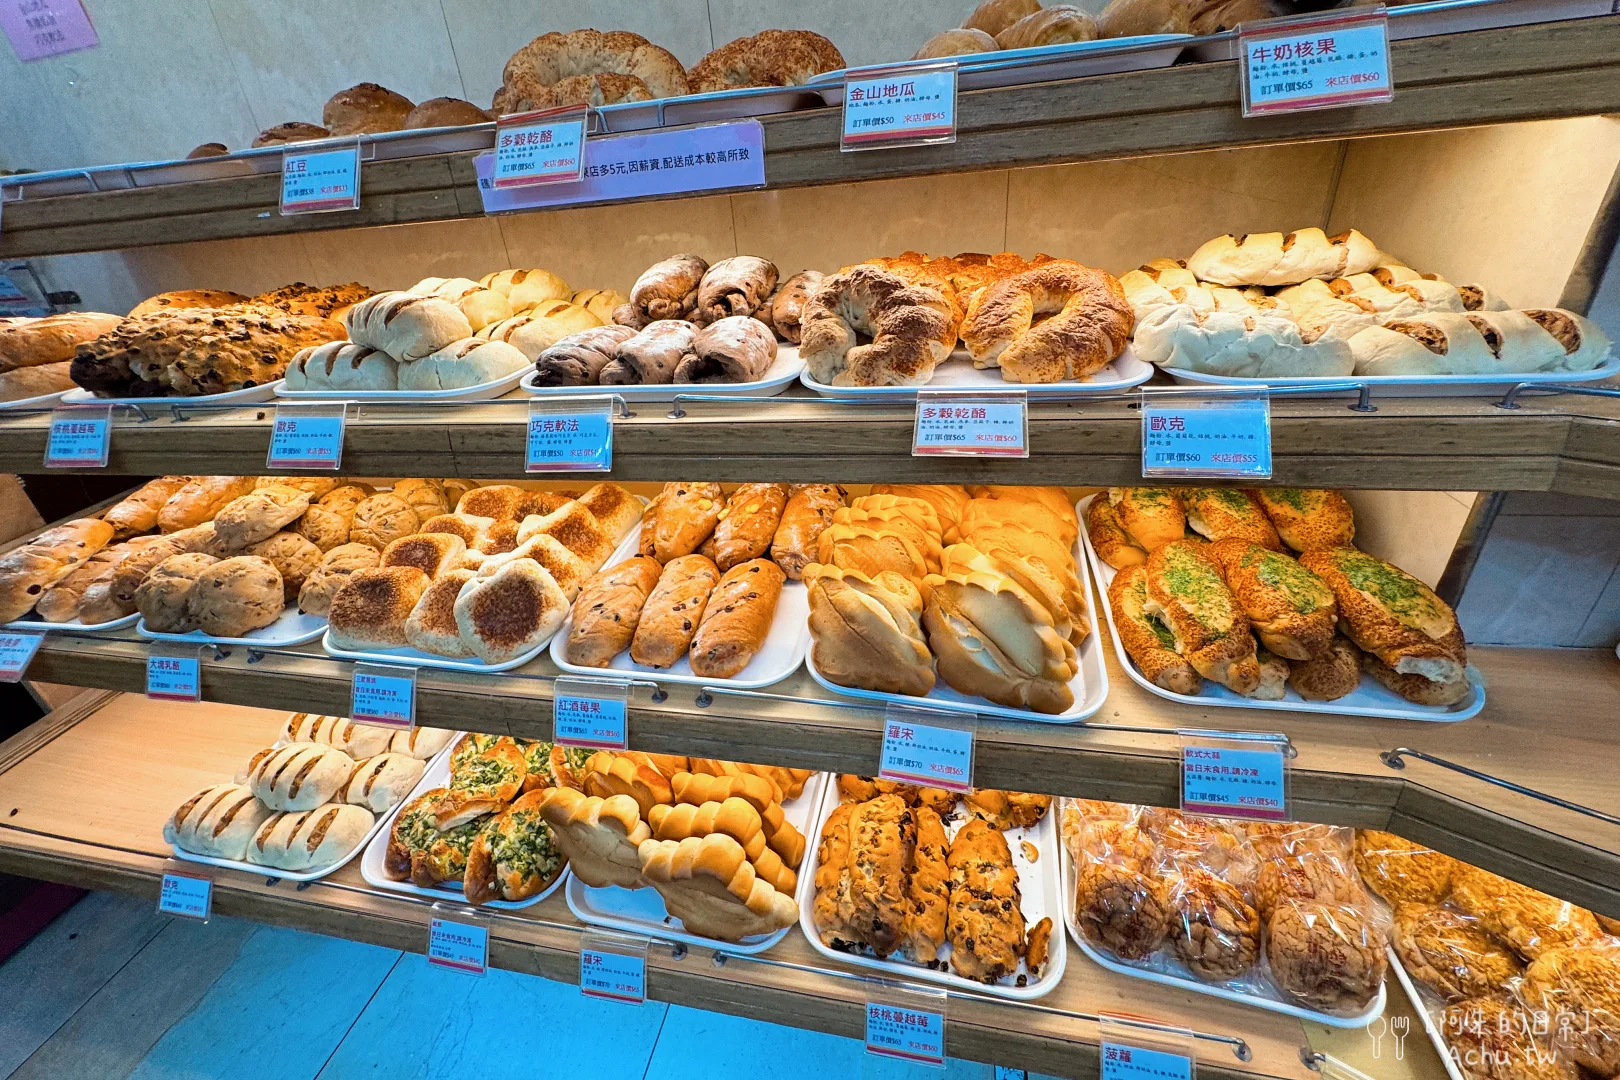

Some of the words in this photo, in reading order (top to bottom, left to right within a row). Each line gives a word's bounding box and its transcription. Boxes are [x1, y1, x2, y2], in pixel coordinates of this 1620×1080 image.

[1252, 38, 1337, 63] 牛奶核果
[1325, 72, 1380, 87] 來店價$60
[850, 82, 915, 101] 金山地瓜
[1261, 80, 1313, 95] 訂單價$65
[852, 116, 895, 128] 訂單價$50
[903, 112, 946, 123] 來店價$45
[501, 130, 553, 147] 多穀乾酪
[286, 160, 307, 173] 紅豆
[502, 162, 535, 172] 訂單價$65
[922, 408, 987, 419] 多穀乾酪
[276, 421, 297, 432] 歐克
[531, 419, 580, 433] 巧克軟法
[1150, 416, 1186, 431] 歐克
[924, 433, 966, 441] 訂單價$65
[1155, 452, 1201, 462] 訂單價$60
[1211, 453, 1258, 463] 來店價$55
[558, 700, 600, 713] 紅酒莓果
[888, 724, 914, 740] 羅宋
[1185, 749, 1221, 759] 軟式大蒜
[888, 756, 923, 768] 訂單價$70
[1189, 792, 1229, 802] 訂單價$45
[583, 953, 603, 966] 羅宋
[869, 1007, 929, 1027] 核桃蔓越莓
[1105, 1047, 1132, 1063] 菠蘿
